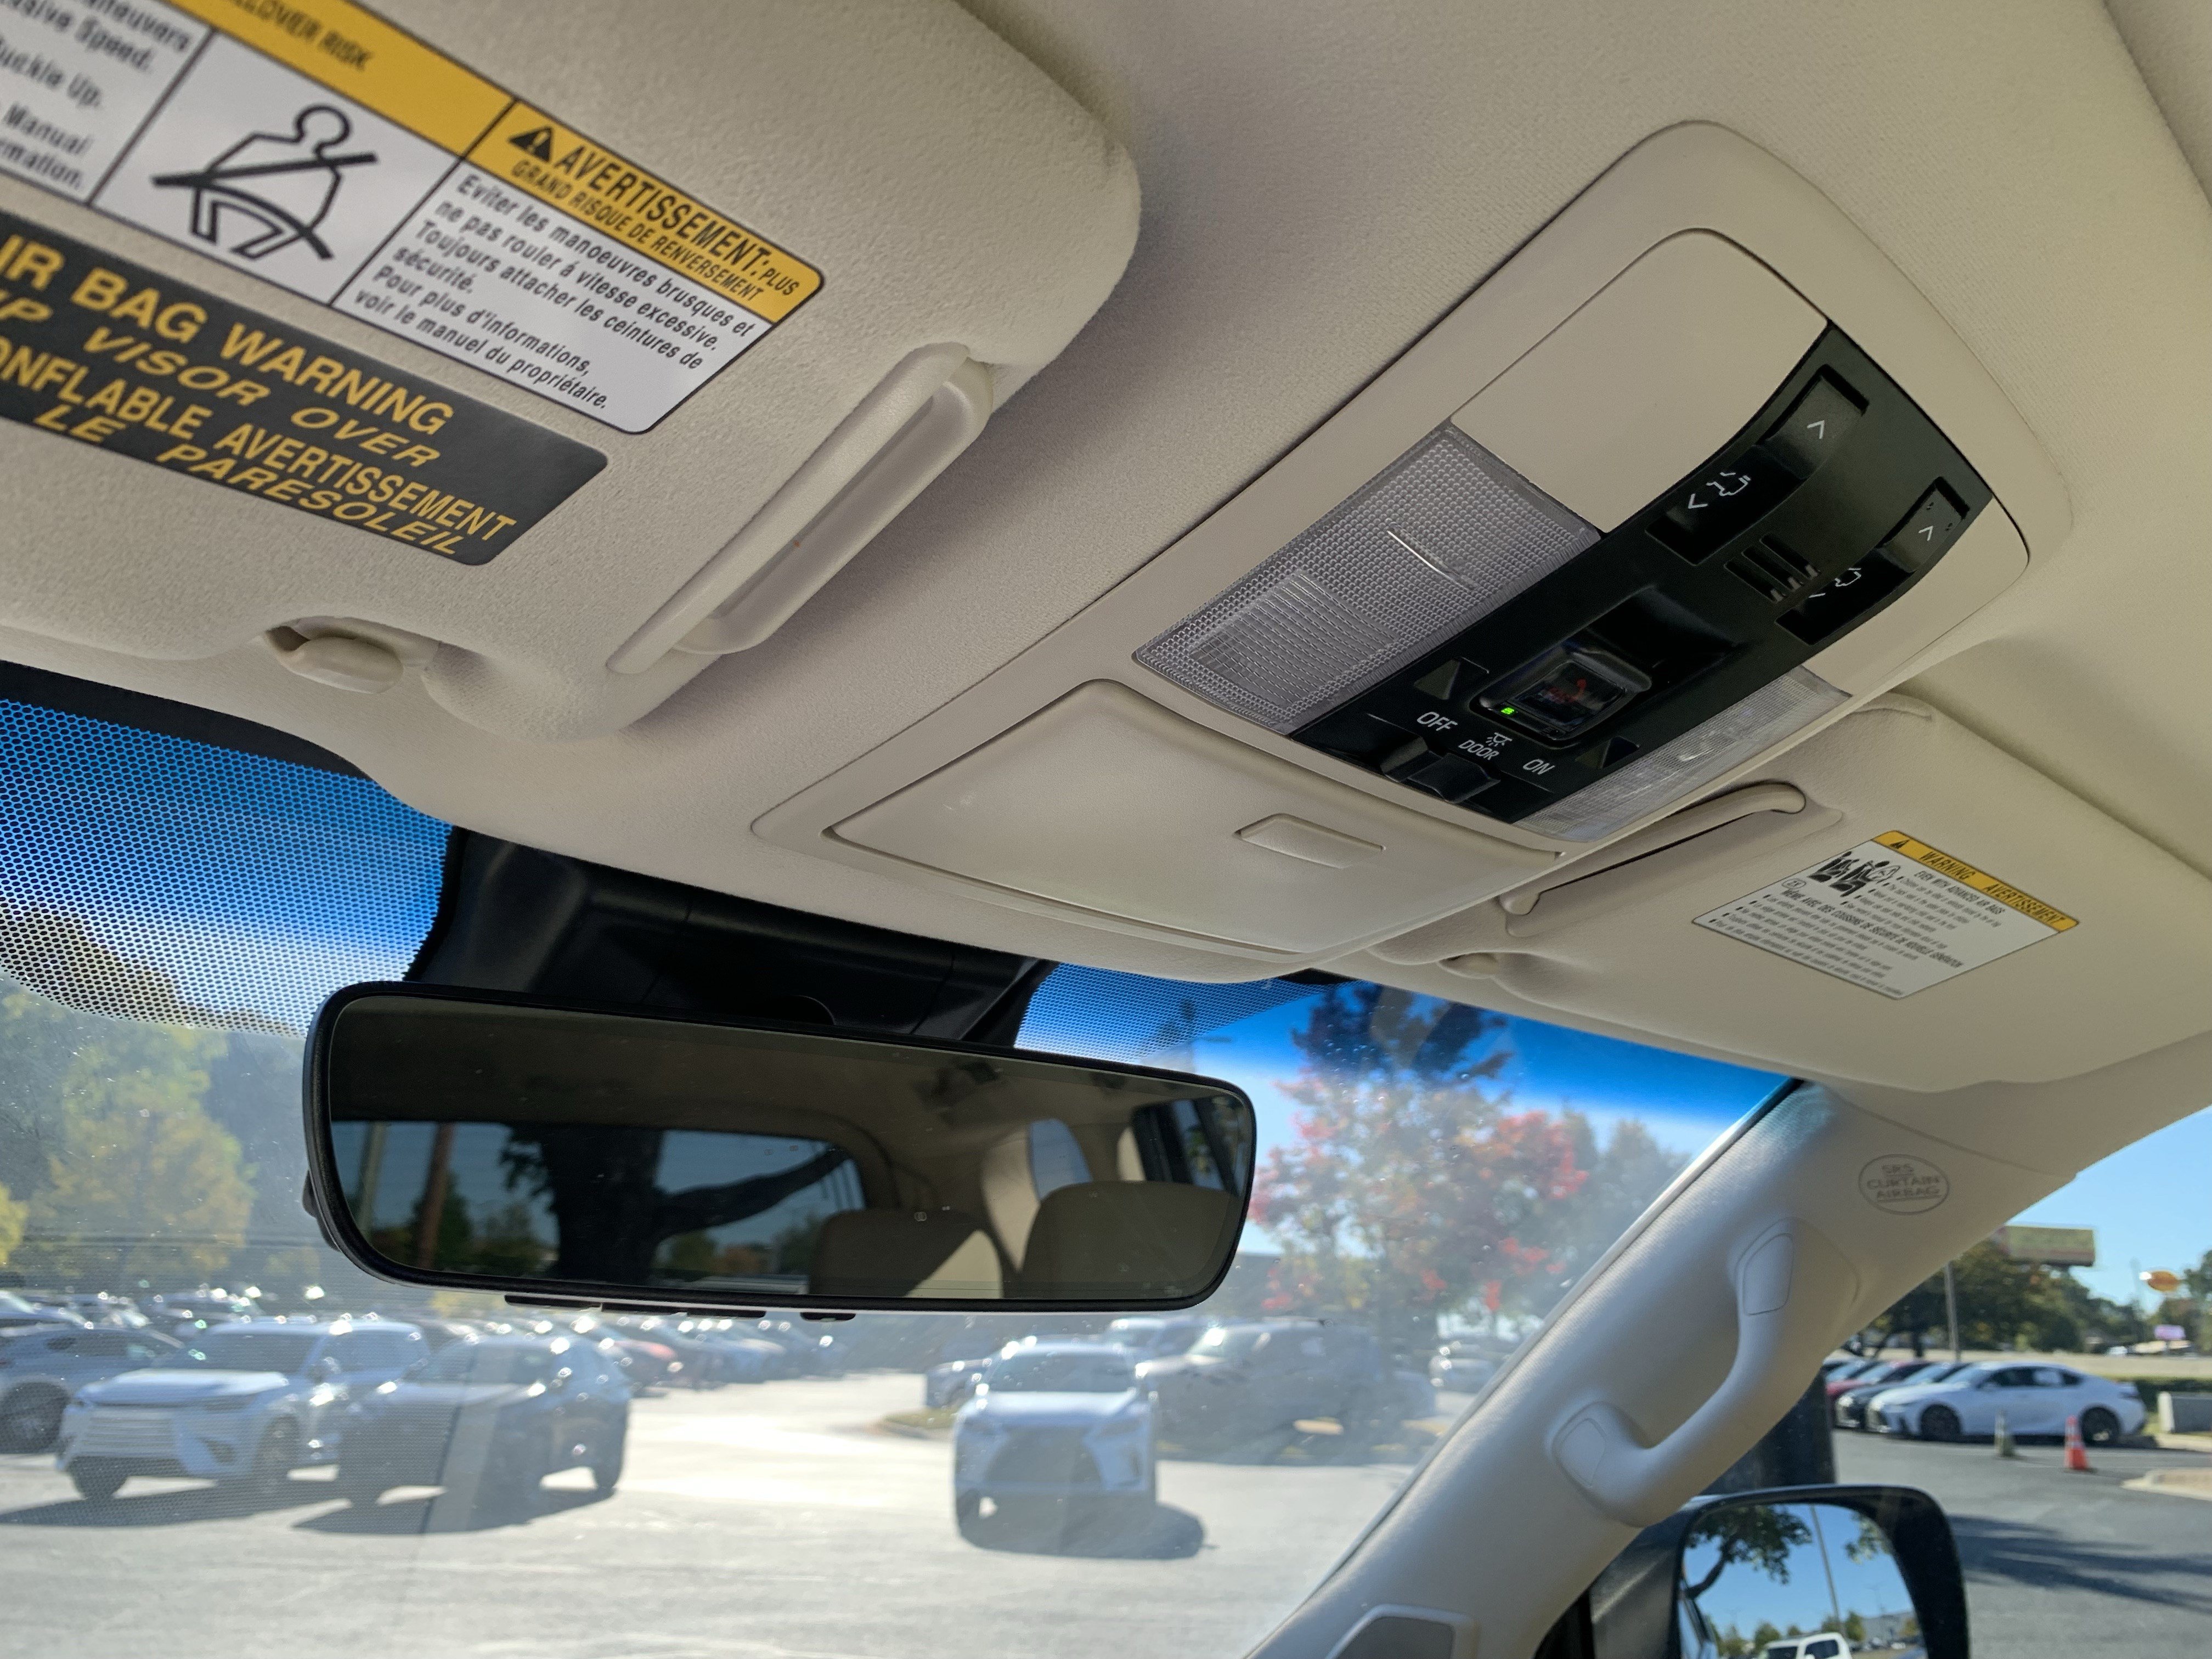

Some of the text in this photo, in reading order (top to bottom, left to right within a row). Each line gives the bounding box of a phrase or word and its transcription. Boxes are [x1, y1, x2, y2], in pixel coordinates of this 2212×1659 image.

[2, 102, 93, 156] Manual
[392, 246, 477, 295] sécurité.
[435, 200, 465, 223] ne
[458, 215, 503, 242] pas
[501, 234, 563, 270] rouler
[575, 270, 639, 308] vitesse
[636, 301, 719, 351] excessive.
[511, 160, 764, 302] GRAND RISQUE DE RENVERSEMENT
[516, 205, 550, 233] les
[549, 225, 658, 288] manoeuvres
[656, 278, 735, 328] brusques
[732, 319, 757, 337] et
[758, 266, 799, 296] PLUS
[70, 267, 208, 344] BAG
[219, 322, 454, 438] WARNING
[354, 289, 608, 409] voir le manuel du propriétaire.
[373, 264, 591, 377] Pour plus d'informations,
[415, 219, 704, 370] Toujours attacher les ceintures de
[82, 326, 271, 407] VISOR
[290, 407, 440, 469] OVER
[33, 403, 461, 556] LE PARESOLEIL
[213, 423, 517, 542] AVERTISSEMENT
[1416, 711, 1459, 732] OFF
[1458, 739, 1501, 762] DOOR
[1521, 758, 1556, 776] ON
[1918, 851, 1976, 880] WARNING
[1982, 883, 2066, 923] AVERTISSEMENT
